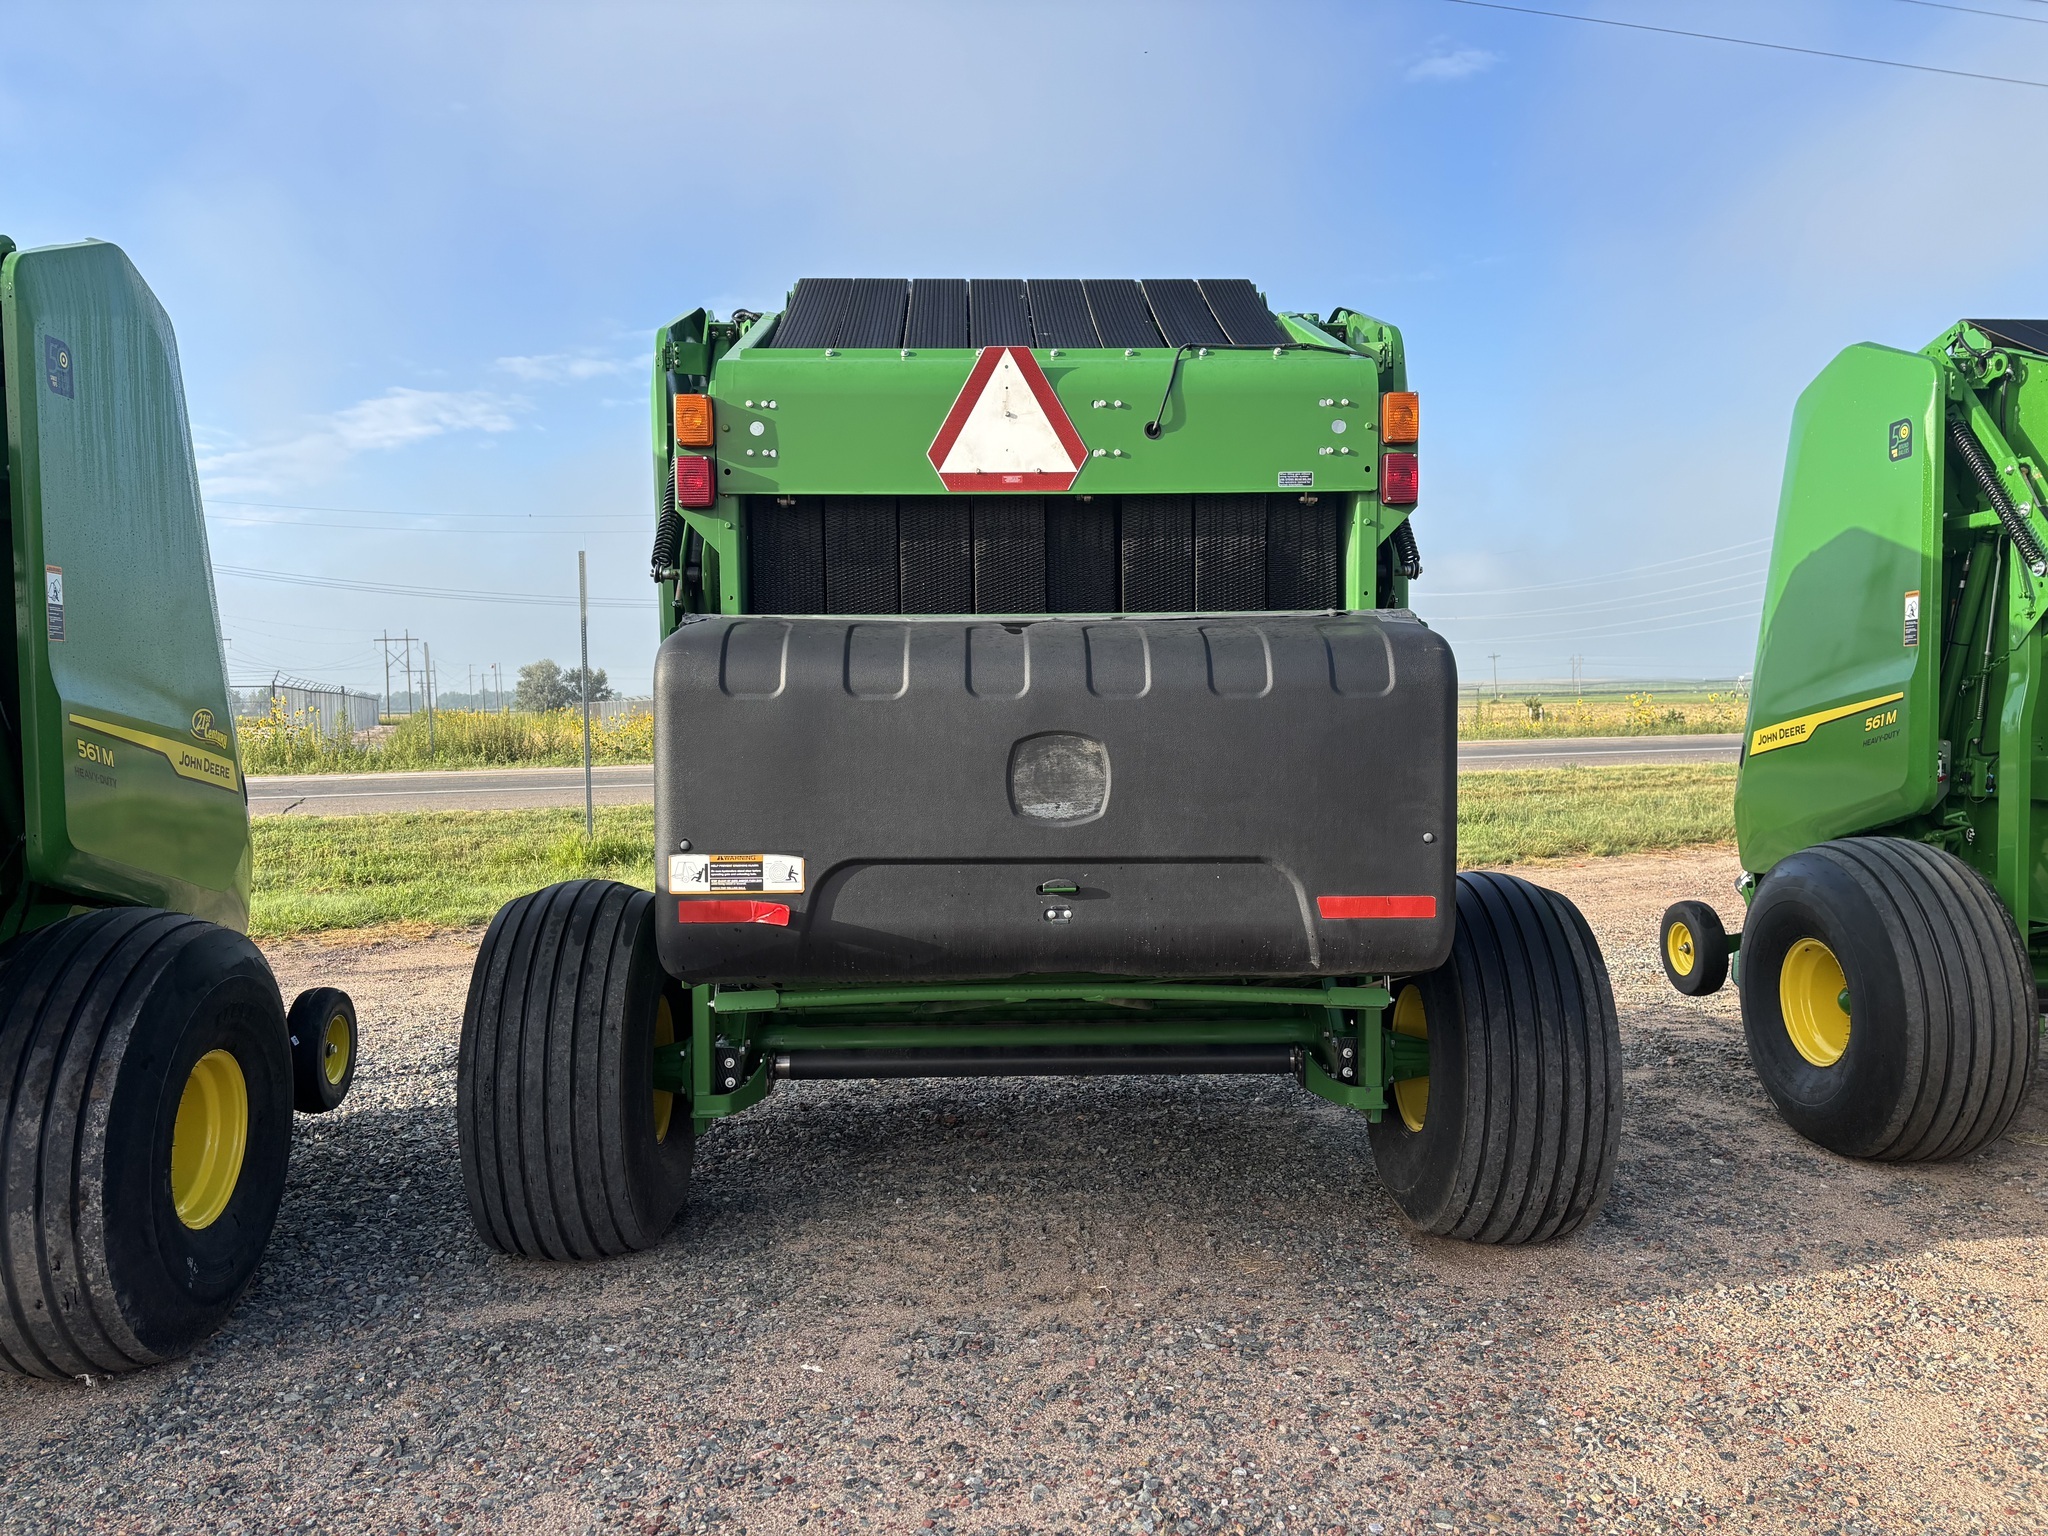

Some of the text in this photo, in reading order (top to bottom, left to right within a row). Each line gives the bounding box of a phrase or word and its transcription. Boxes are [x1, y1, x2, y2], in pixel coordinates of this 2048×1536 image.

[1757, 724, 1806, 746] JOHN DEERE
[1862, 729, 1900, 747] HEAVY-DUTY
[178, 750, 230, 779] JOHN DEERE
[74, 766, 117, 789] HEAVY-DUTY
